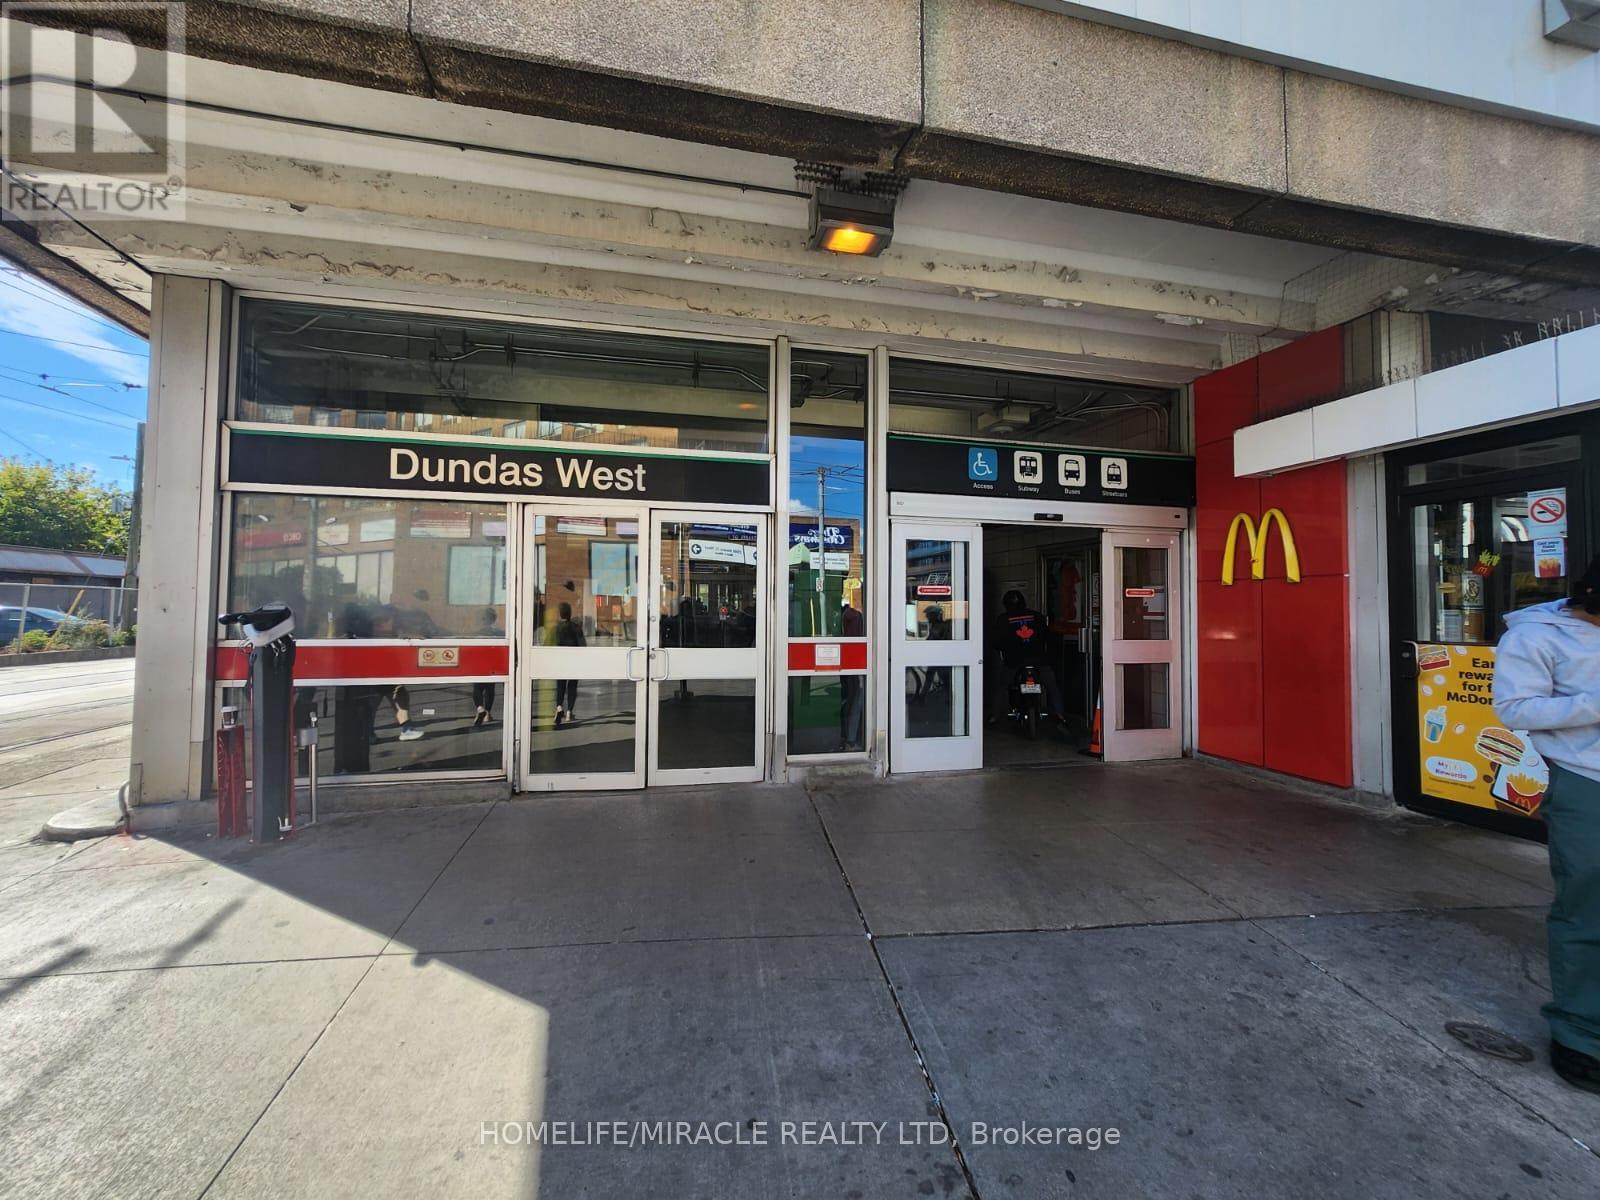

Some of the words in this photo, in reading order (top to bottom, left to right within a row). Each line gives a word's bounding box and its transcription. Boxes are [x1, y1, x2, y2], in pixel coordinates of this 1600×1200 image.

[389, 447, 544, 488] Dundas
[555, 457, 647, 492] West
[972, 481, 994, 491] Access
[1017, 484, 1040, 495] Subway
[1064, 487, 1081, 496] Buses
[1101, 489, 1128, 499] Streetcars
[1462, 680, 1483, 692] for
